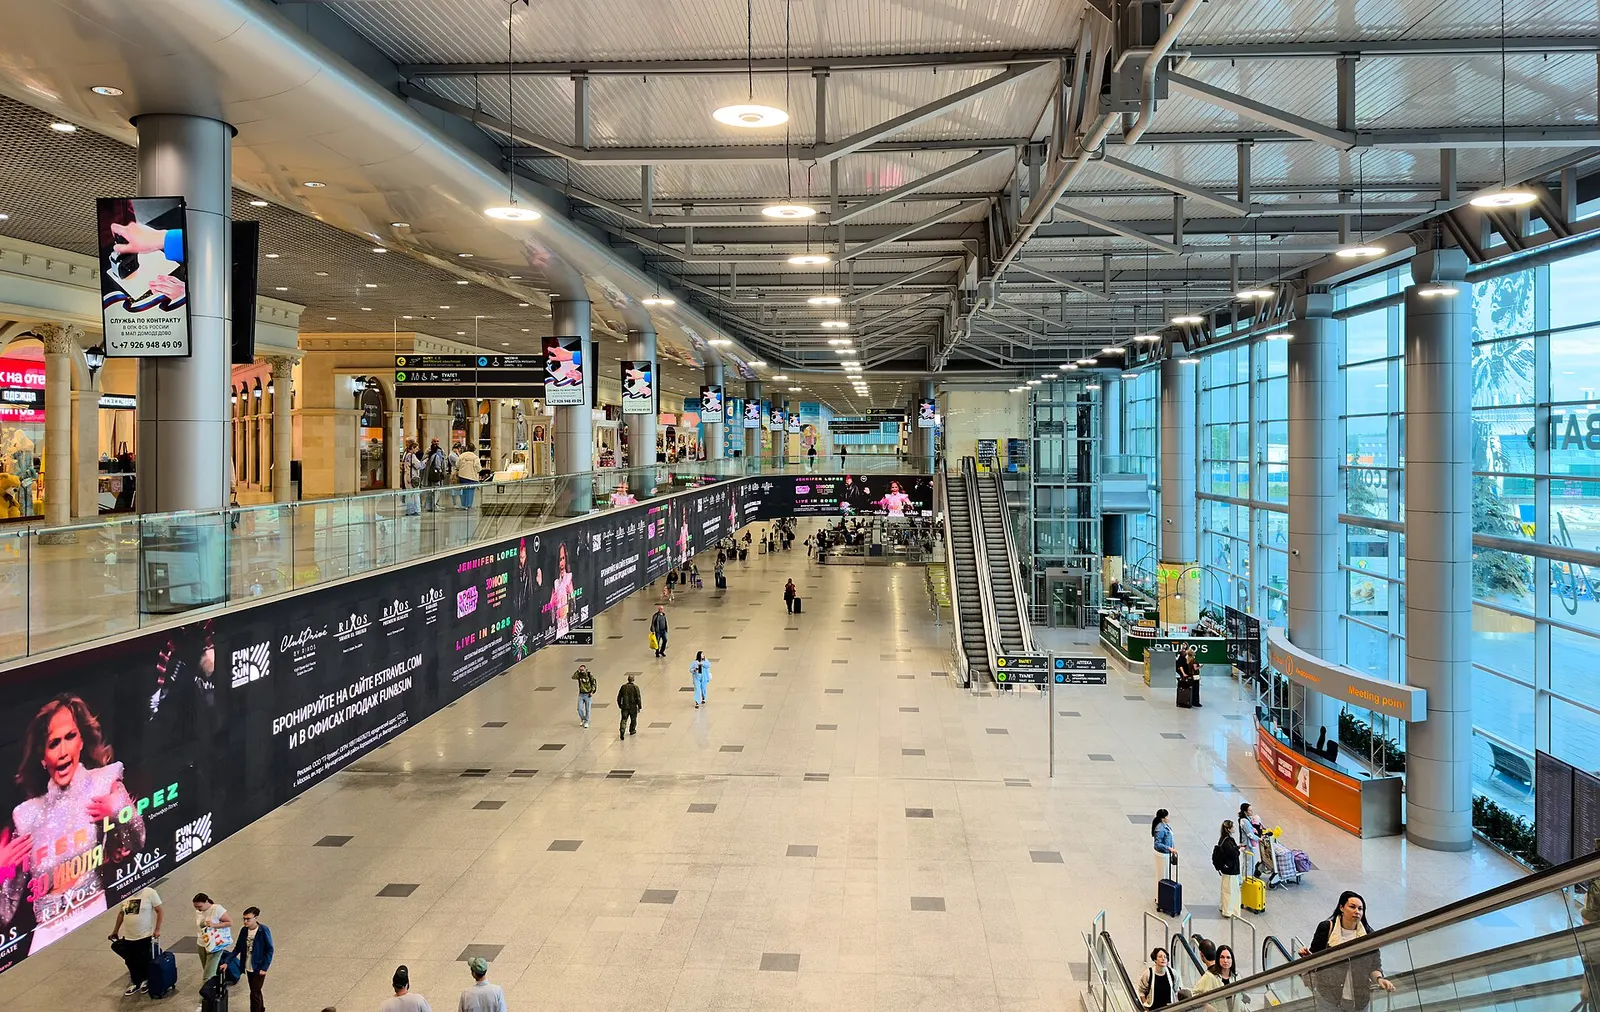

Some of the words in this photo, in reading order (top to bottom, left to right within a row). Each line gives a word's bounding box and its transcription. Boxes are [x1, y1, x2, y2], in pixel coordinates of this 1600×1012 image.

[119, 341, 128, 349] +7
[129, 341, 144, 349] 926
[145, 341, 160, 349] 948
[161, 341, 171, 349] 49
[172, 340, 183, 349] 09
[457, 554, 494, 574] JENNIFER
[496, 547, 519, 562] LOPEZ
[382, 598, 410, 618] RIXOS
[420, 587, 444, 605] RIXOS
[338, 612, 369, 633] RIXOS
[455, 632, 476, 652] LIVE
[478, 627, 488, 640] IN
[490, 616, 511, 635] 2025
[232, 647, 250, 666] FUN
[232, 661, 250, 681] SUN
[272, 692, 335, 735] БРОНИРУЙТЕ
[336, 687, 349, 704] НА
[348, 676, 374, 697] САЙТЕ
[374, 653, 423, 688] FSTRAVEL.COM
[1348, 685, 1380, 704] Meeting
[1382, 696, 1406, 710] point
[289, 731, 298, 750] И
[299, 728, 306, 745] В
[307, 709, 345, 740] ОФИСАХ
[345, 692, 379, 720] ПРОДАЖ
[379, 676, 412, 704] FUN&SUN
[103, 782, 179, 833] LOPEZ
[175, 822, 192, 842] FUN
[175, 836, 192, 855] SUN
[26, 872, 50, 903] 30
[53, 844, 104, 888] ИЮЛЯ
[114, 846, 162, 882] RIXOS
[40, 878, 99, 922] RIXOS
